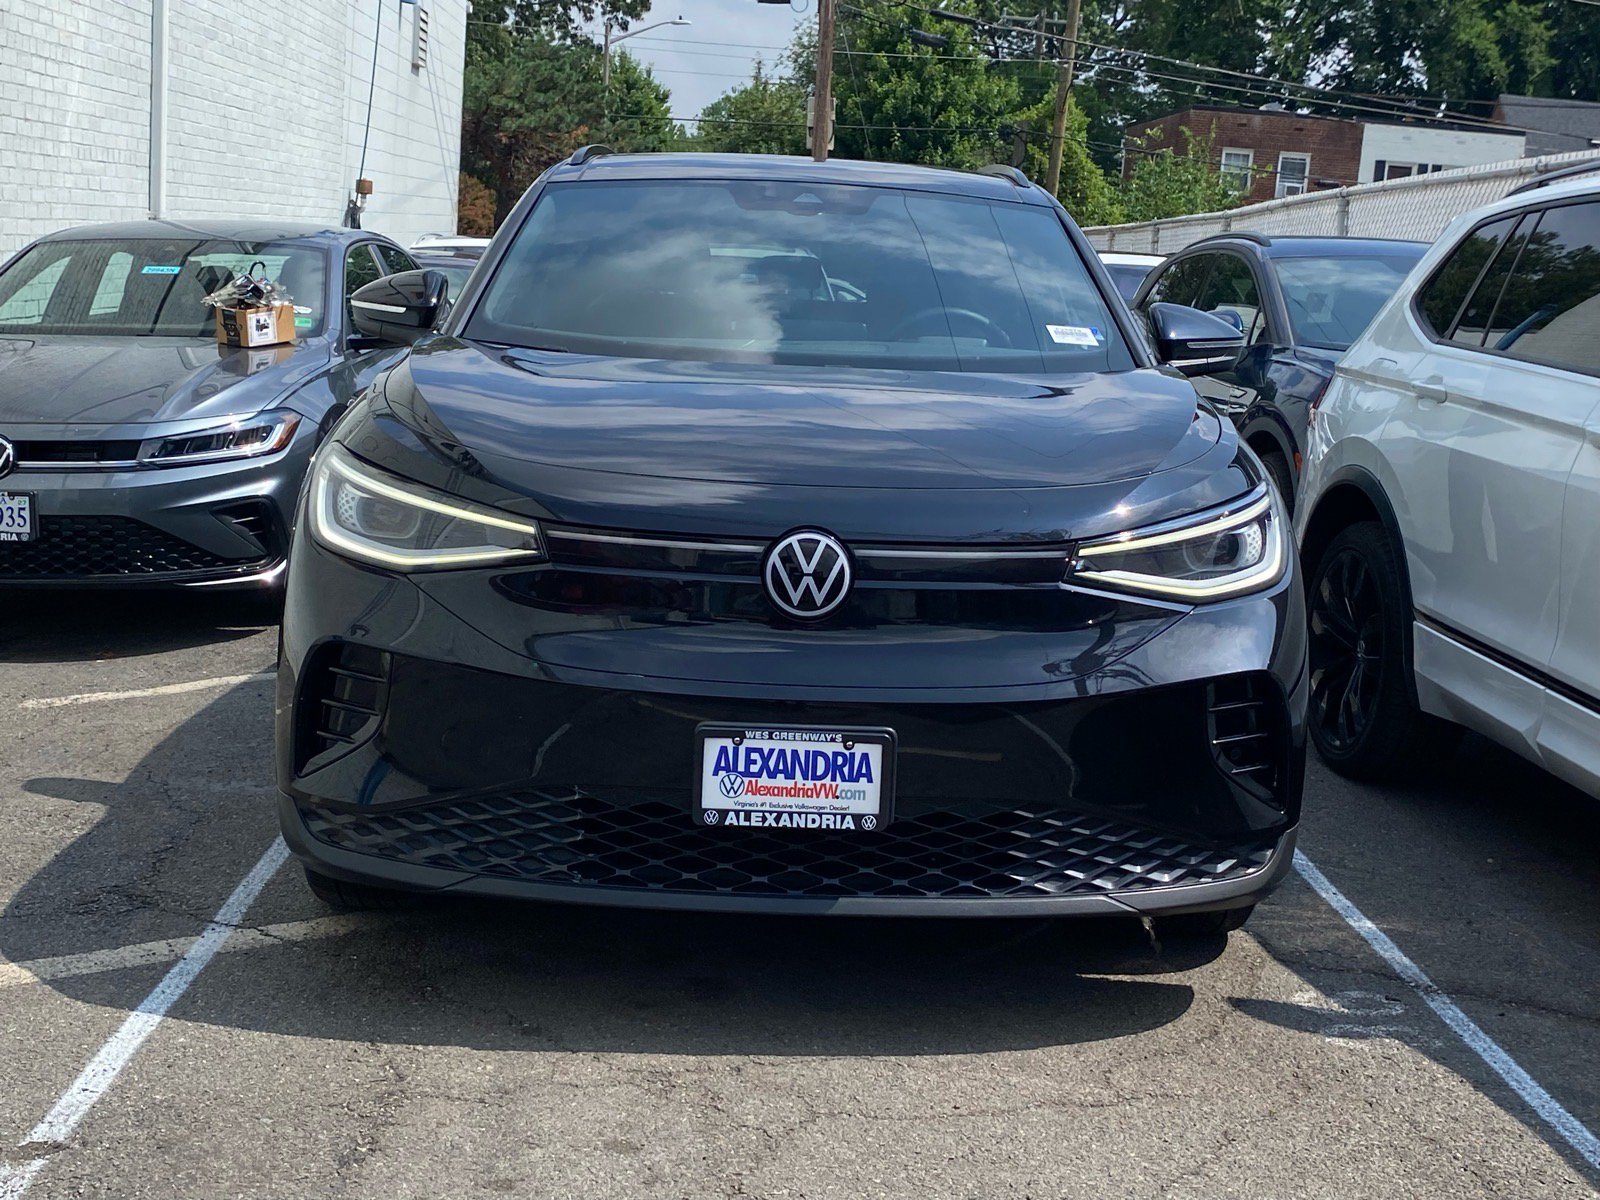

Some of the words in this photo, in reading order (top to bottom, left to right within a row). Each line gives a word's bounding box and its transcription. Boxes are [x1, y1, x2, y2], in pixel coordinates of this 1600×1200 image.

[745, 730, 769, 740] WES
[773, 732, 843, 742] GREENWAY'S
[712, 745, 874, 784] ALEXANDRIA
[744, 779, 866, 800] AlexandriaVW.com
[733, 800, 759, 809] Virginia's
[795, 803, 828, 811] Volkswagen
[724, 811, 856, 830] ALEXANDRIA
